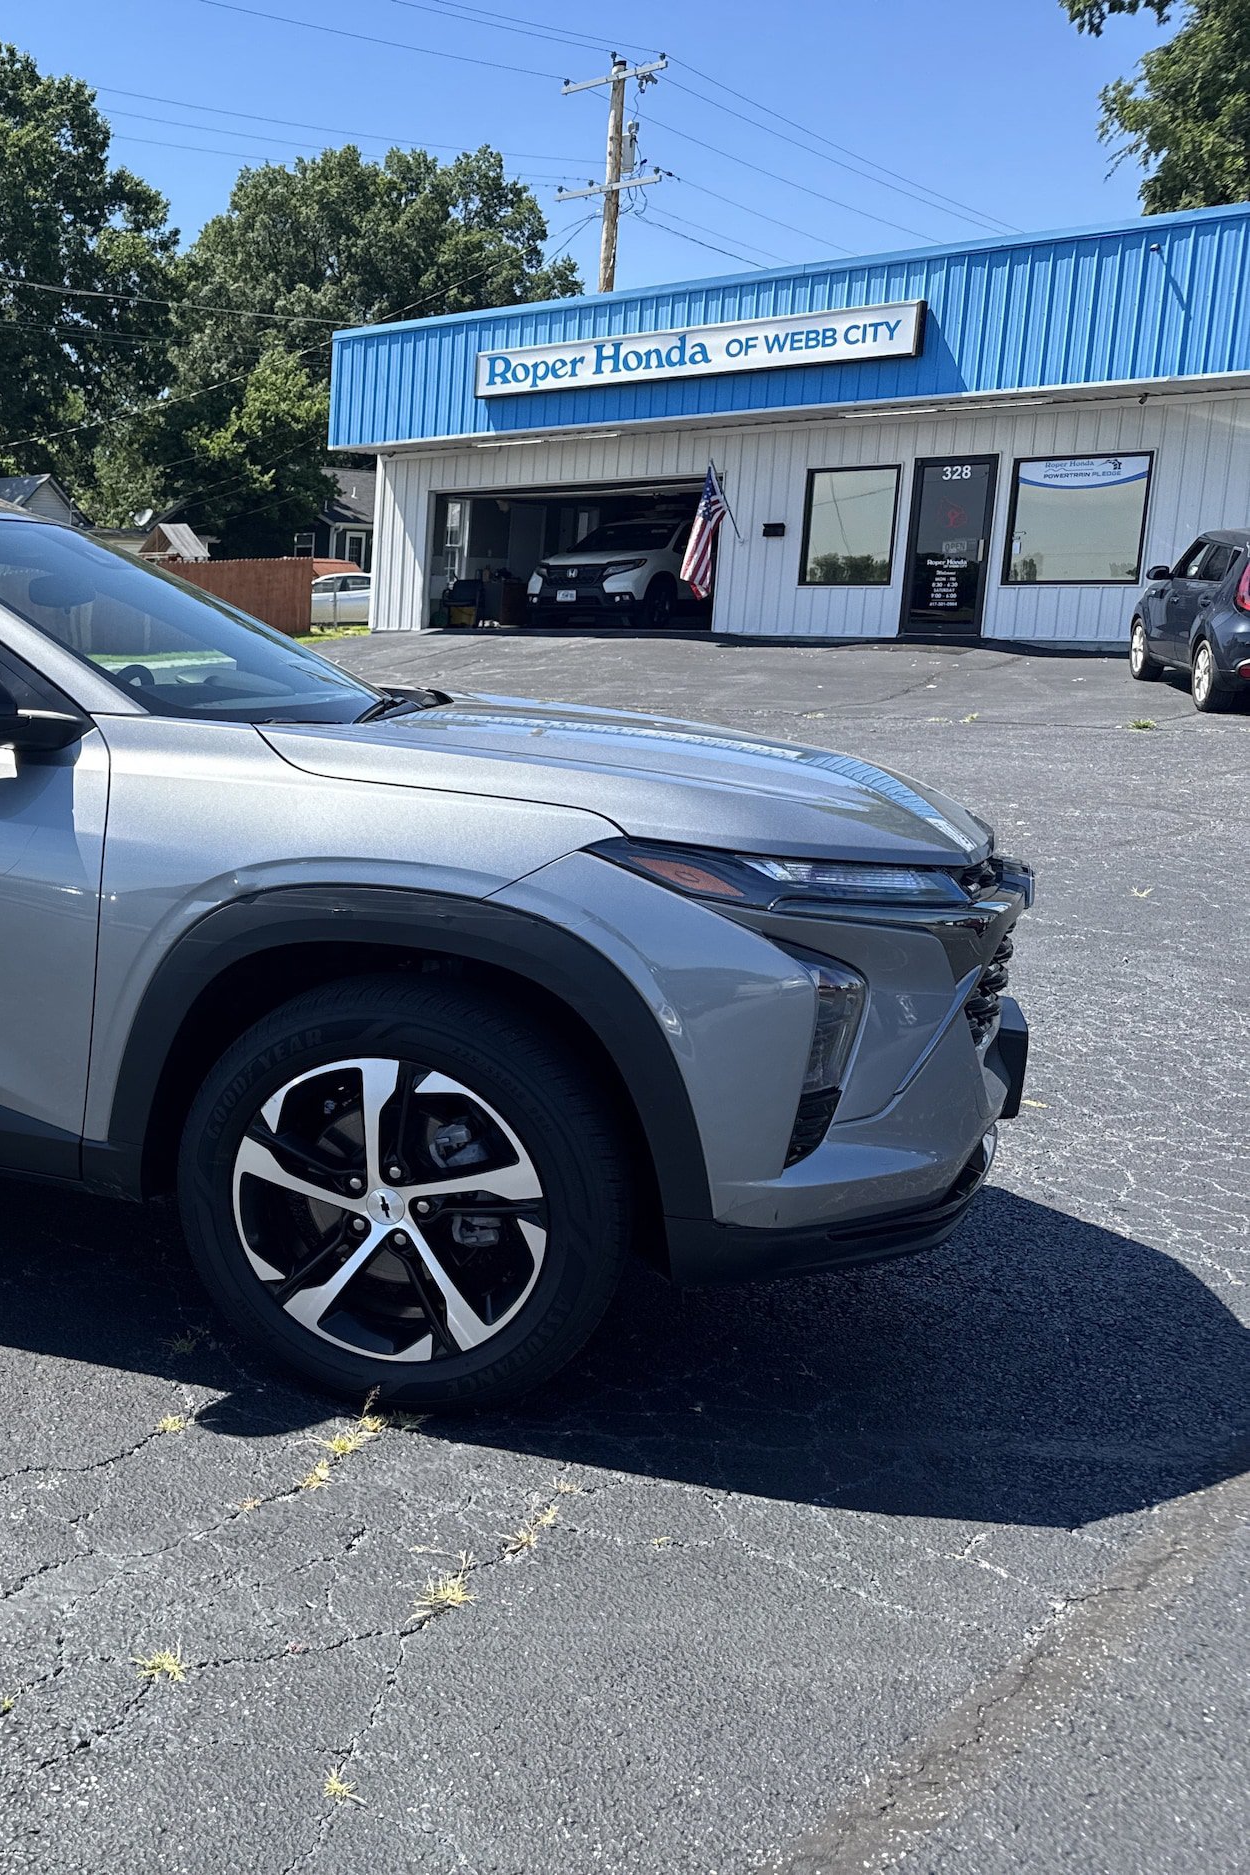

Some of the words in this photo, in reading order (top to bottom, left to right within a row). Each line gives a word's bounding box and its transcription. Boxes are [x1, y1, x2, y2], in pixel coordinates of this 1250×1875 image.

[486, 354, 584, 389] Roper
[593, 334, 712, 375] Honda
[725, 337, 759, 359] OF
[764, 328, 838, 354] WEBB
[843, 319, 903, 343] CITY
[1044, 461, 1068, 469] Roper
[1069, 459, 1095, 468] Honda
[941, 465, 972, 481] 328
[1043, 472, 1091, 480] POWERTRAIN
[1091, 470, 1122, 478] PLEDGE
[946, 542, 966, 552] OPEN
